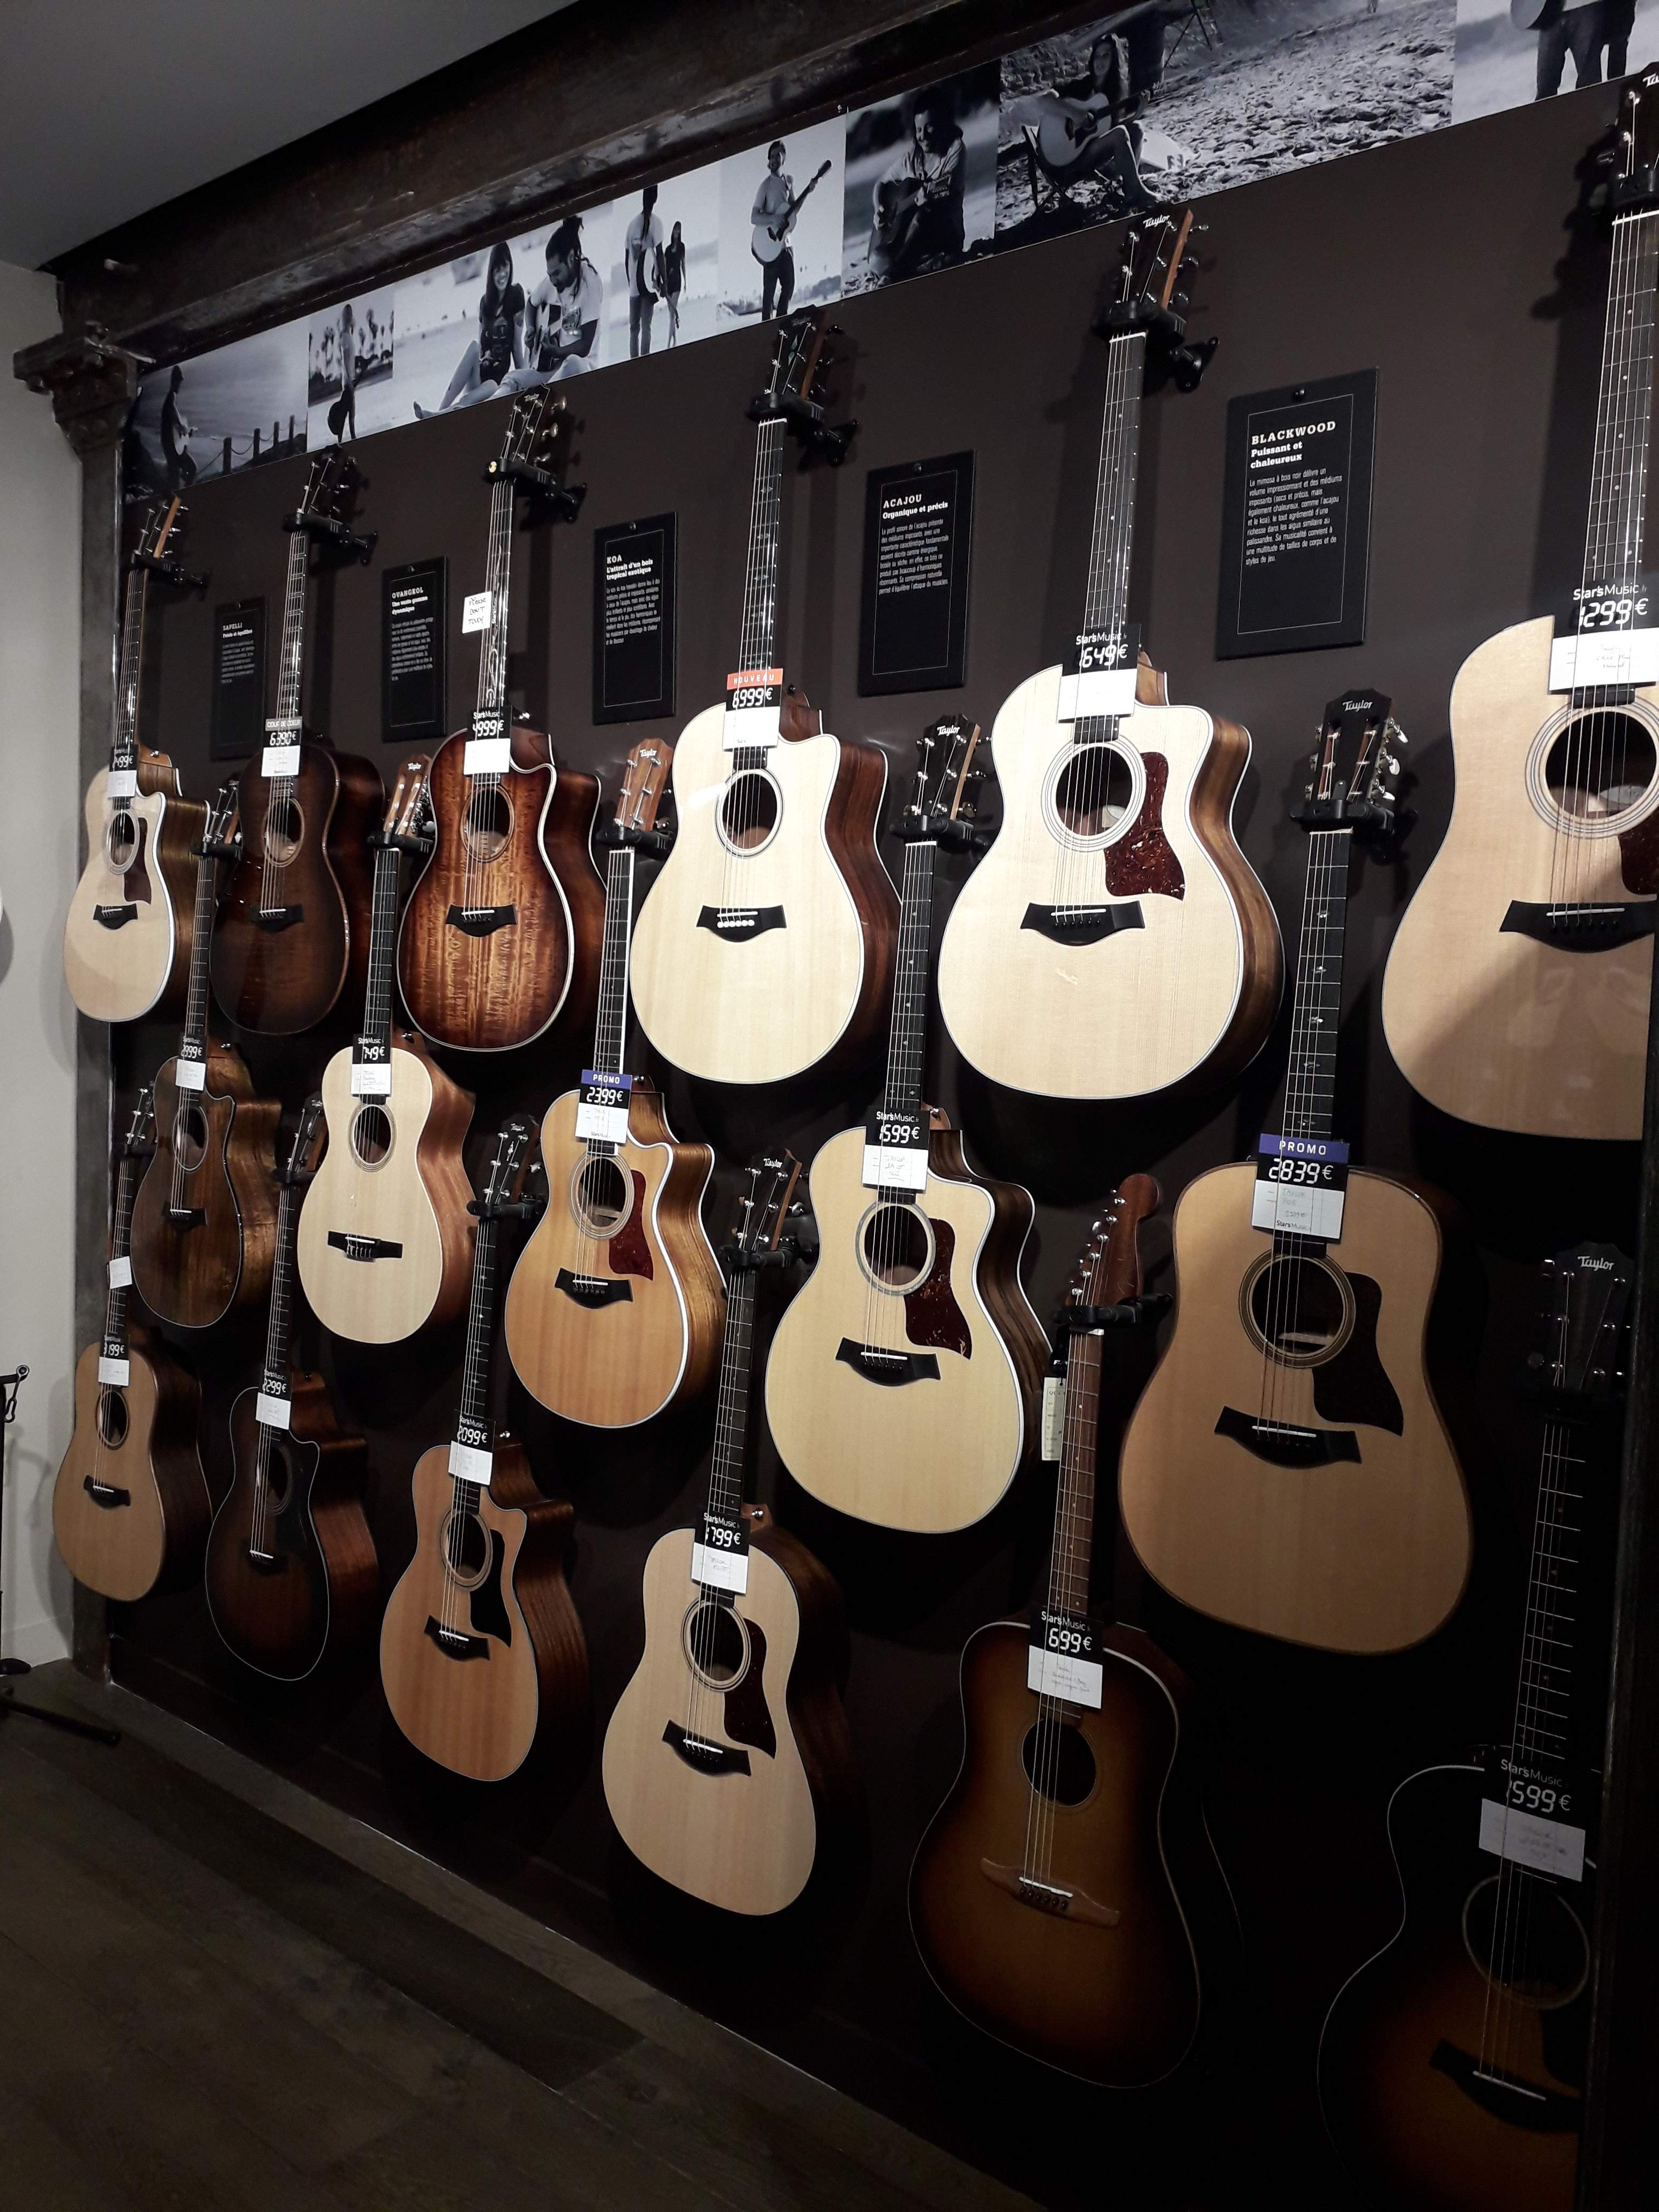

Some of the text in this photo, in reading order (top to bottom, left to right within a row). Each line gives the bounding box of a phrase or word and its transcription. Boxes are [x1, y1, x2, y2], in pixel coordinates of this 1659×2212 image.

[1143, 214, 1170, 229] Taylor
[1251, 421, 1336, 445] BLACKWOOD
[1251, 441, 1303, 457] Puissant et
[1251, 454, 1302, 468] chaleureux
[883, 494, 922, 509] ACAJOU
[883, 508, 918, 519] Organique
[928, 501, 948, 513] précis
[607, 554, 623, 564] KOA
[641, 558, 653, 566] bois
[606, 566, 652, 580] tropical exotique
[1342, 699, 1373, 712] Taylor
[937, 724, 961, 737] Taylor
[593, 1074, 620, 1084] PROMO
[586, 1086, 624, 1105] 2399€
[1279, 1140, 1327, 1155] PROMO
[763, 1158, 783, 1169] Taylor
[1577, 1256, 1615, 1272] Taylor
